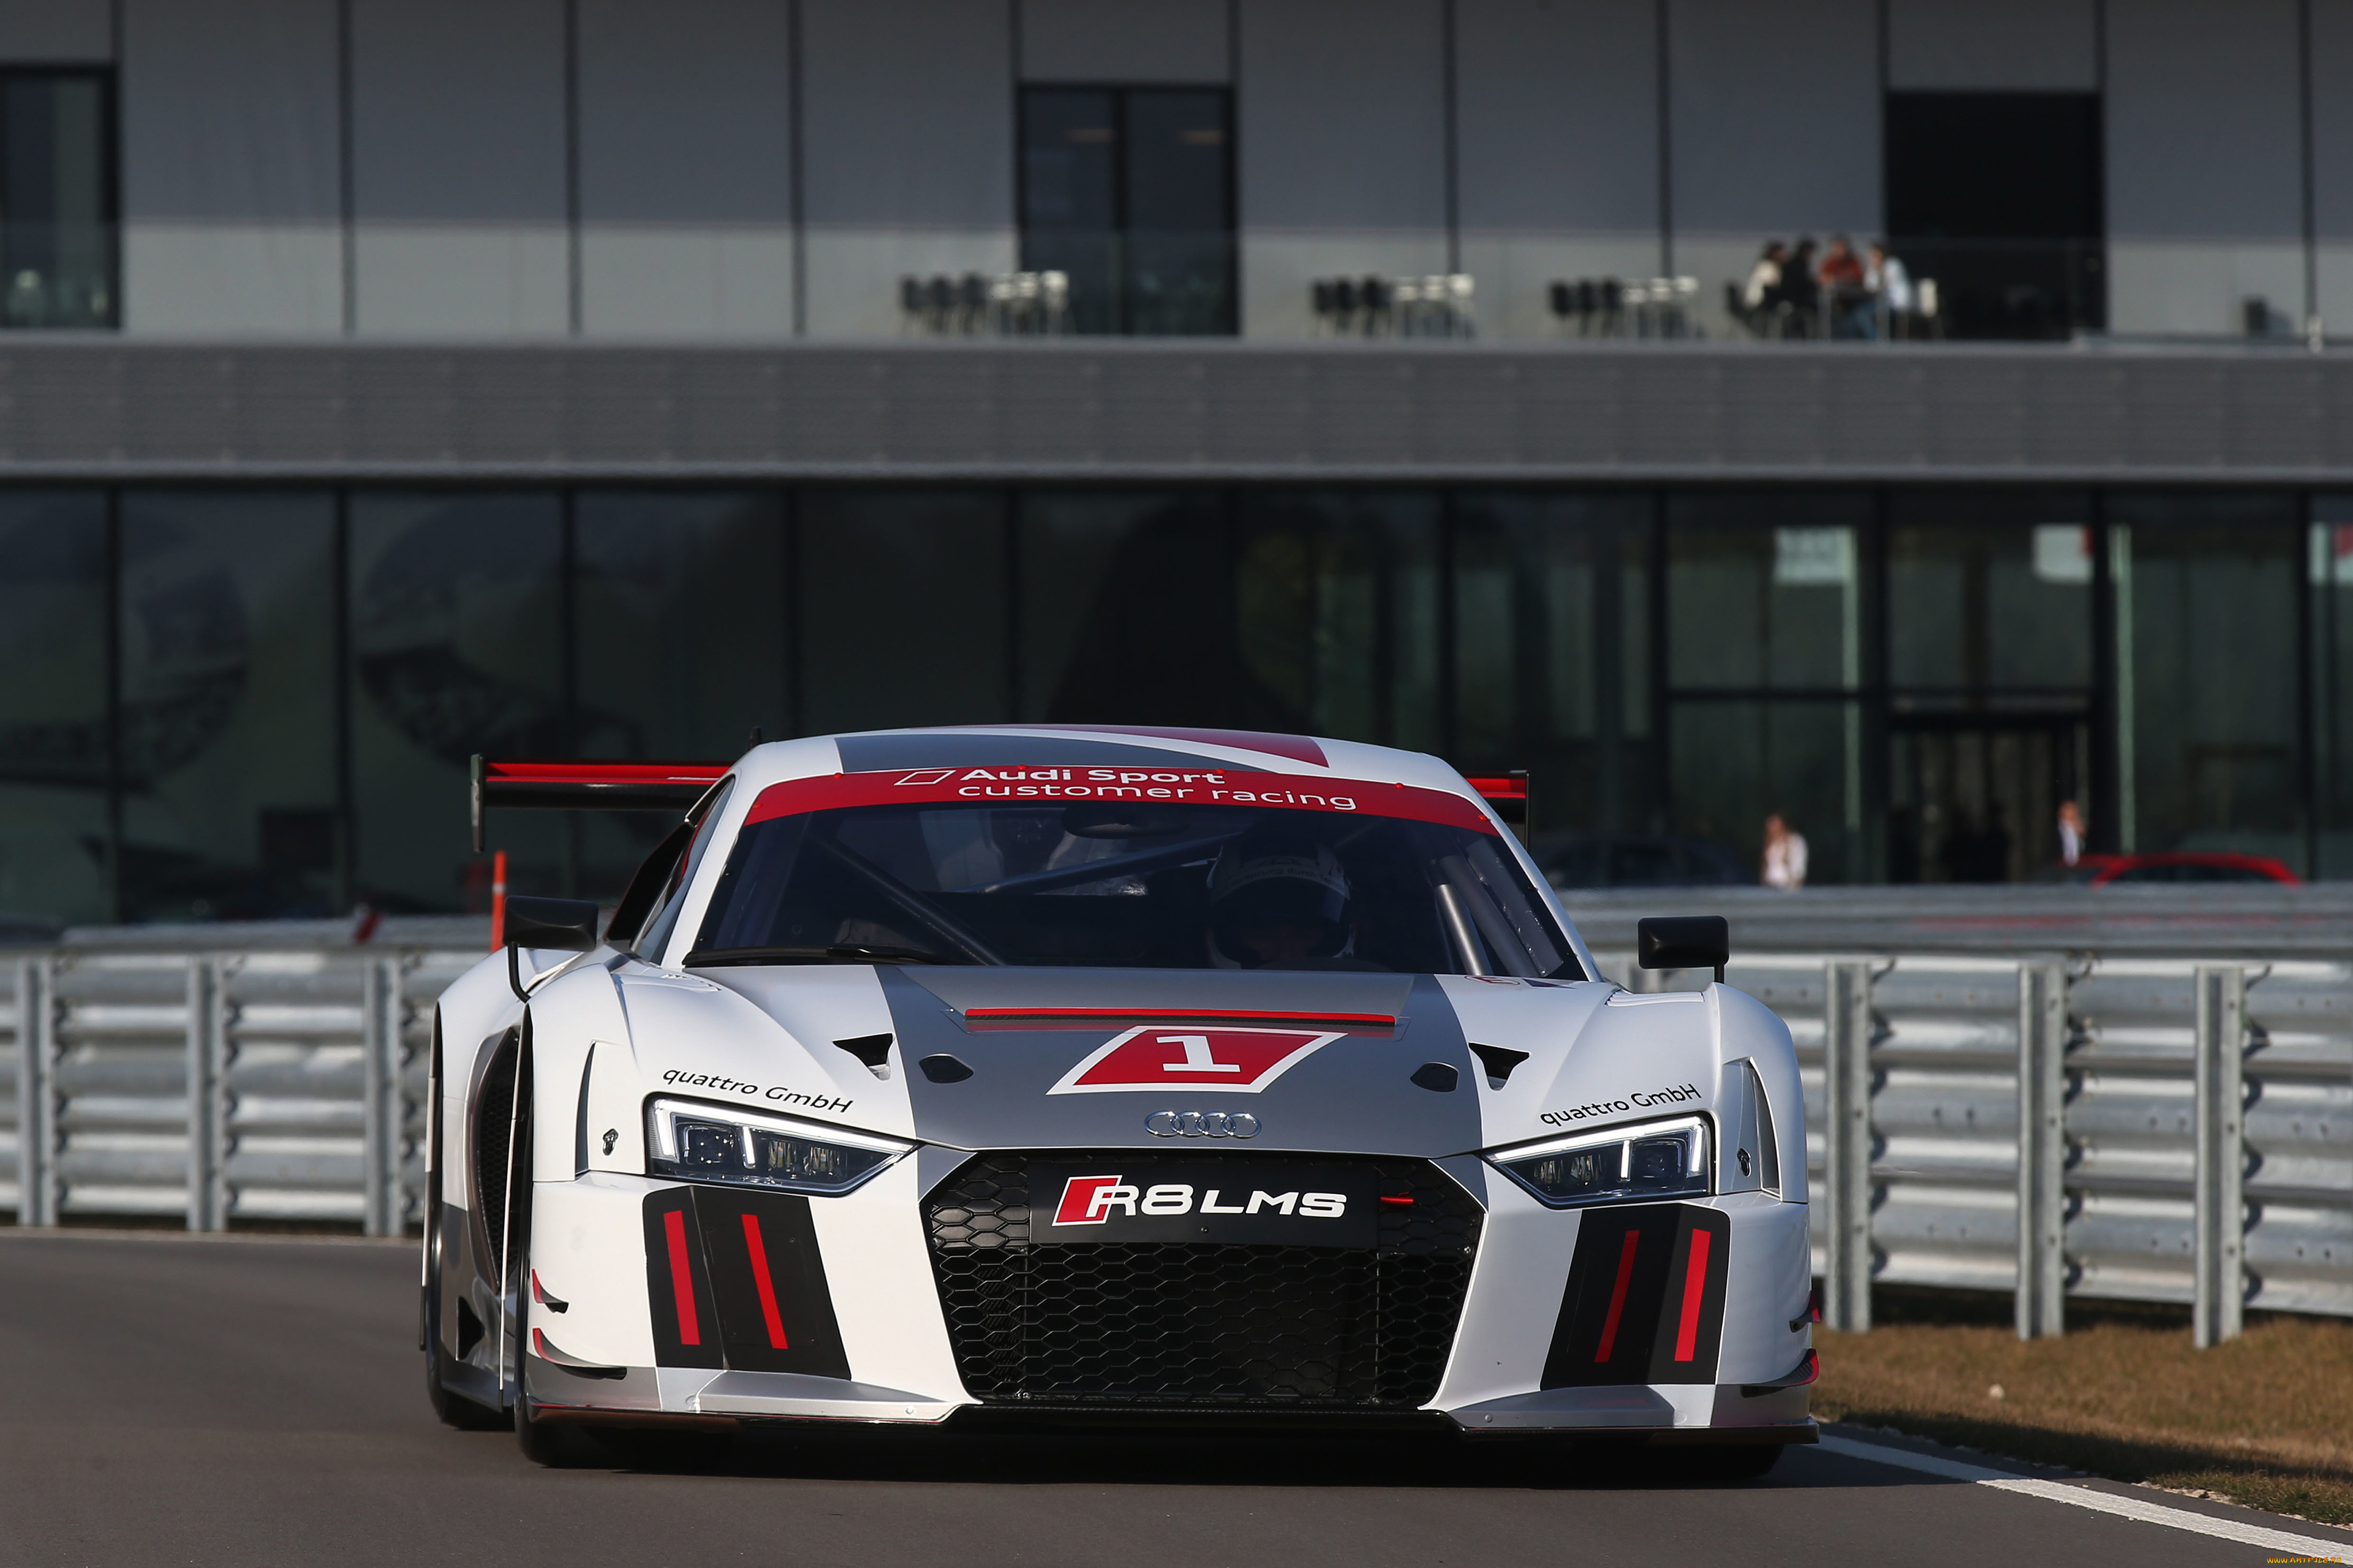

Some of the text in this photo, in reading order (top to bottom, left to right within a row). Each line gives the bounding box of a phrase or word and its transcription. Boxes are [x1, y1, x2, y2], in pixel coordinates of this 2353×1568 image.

[959, 769, 1225, 784] Audi Sport
[958, 784, 1357, 810] customer racing
[1156, 1035, 1241, 1072] 1
[662, 1069, 854, 1113] quattro GmbH
[1540, 1083, 1702, 1127] quattro GmbH
[1199, 1189, 1347, 1218] LMS
